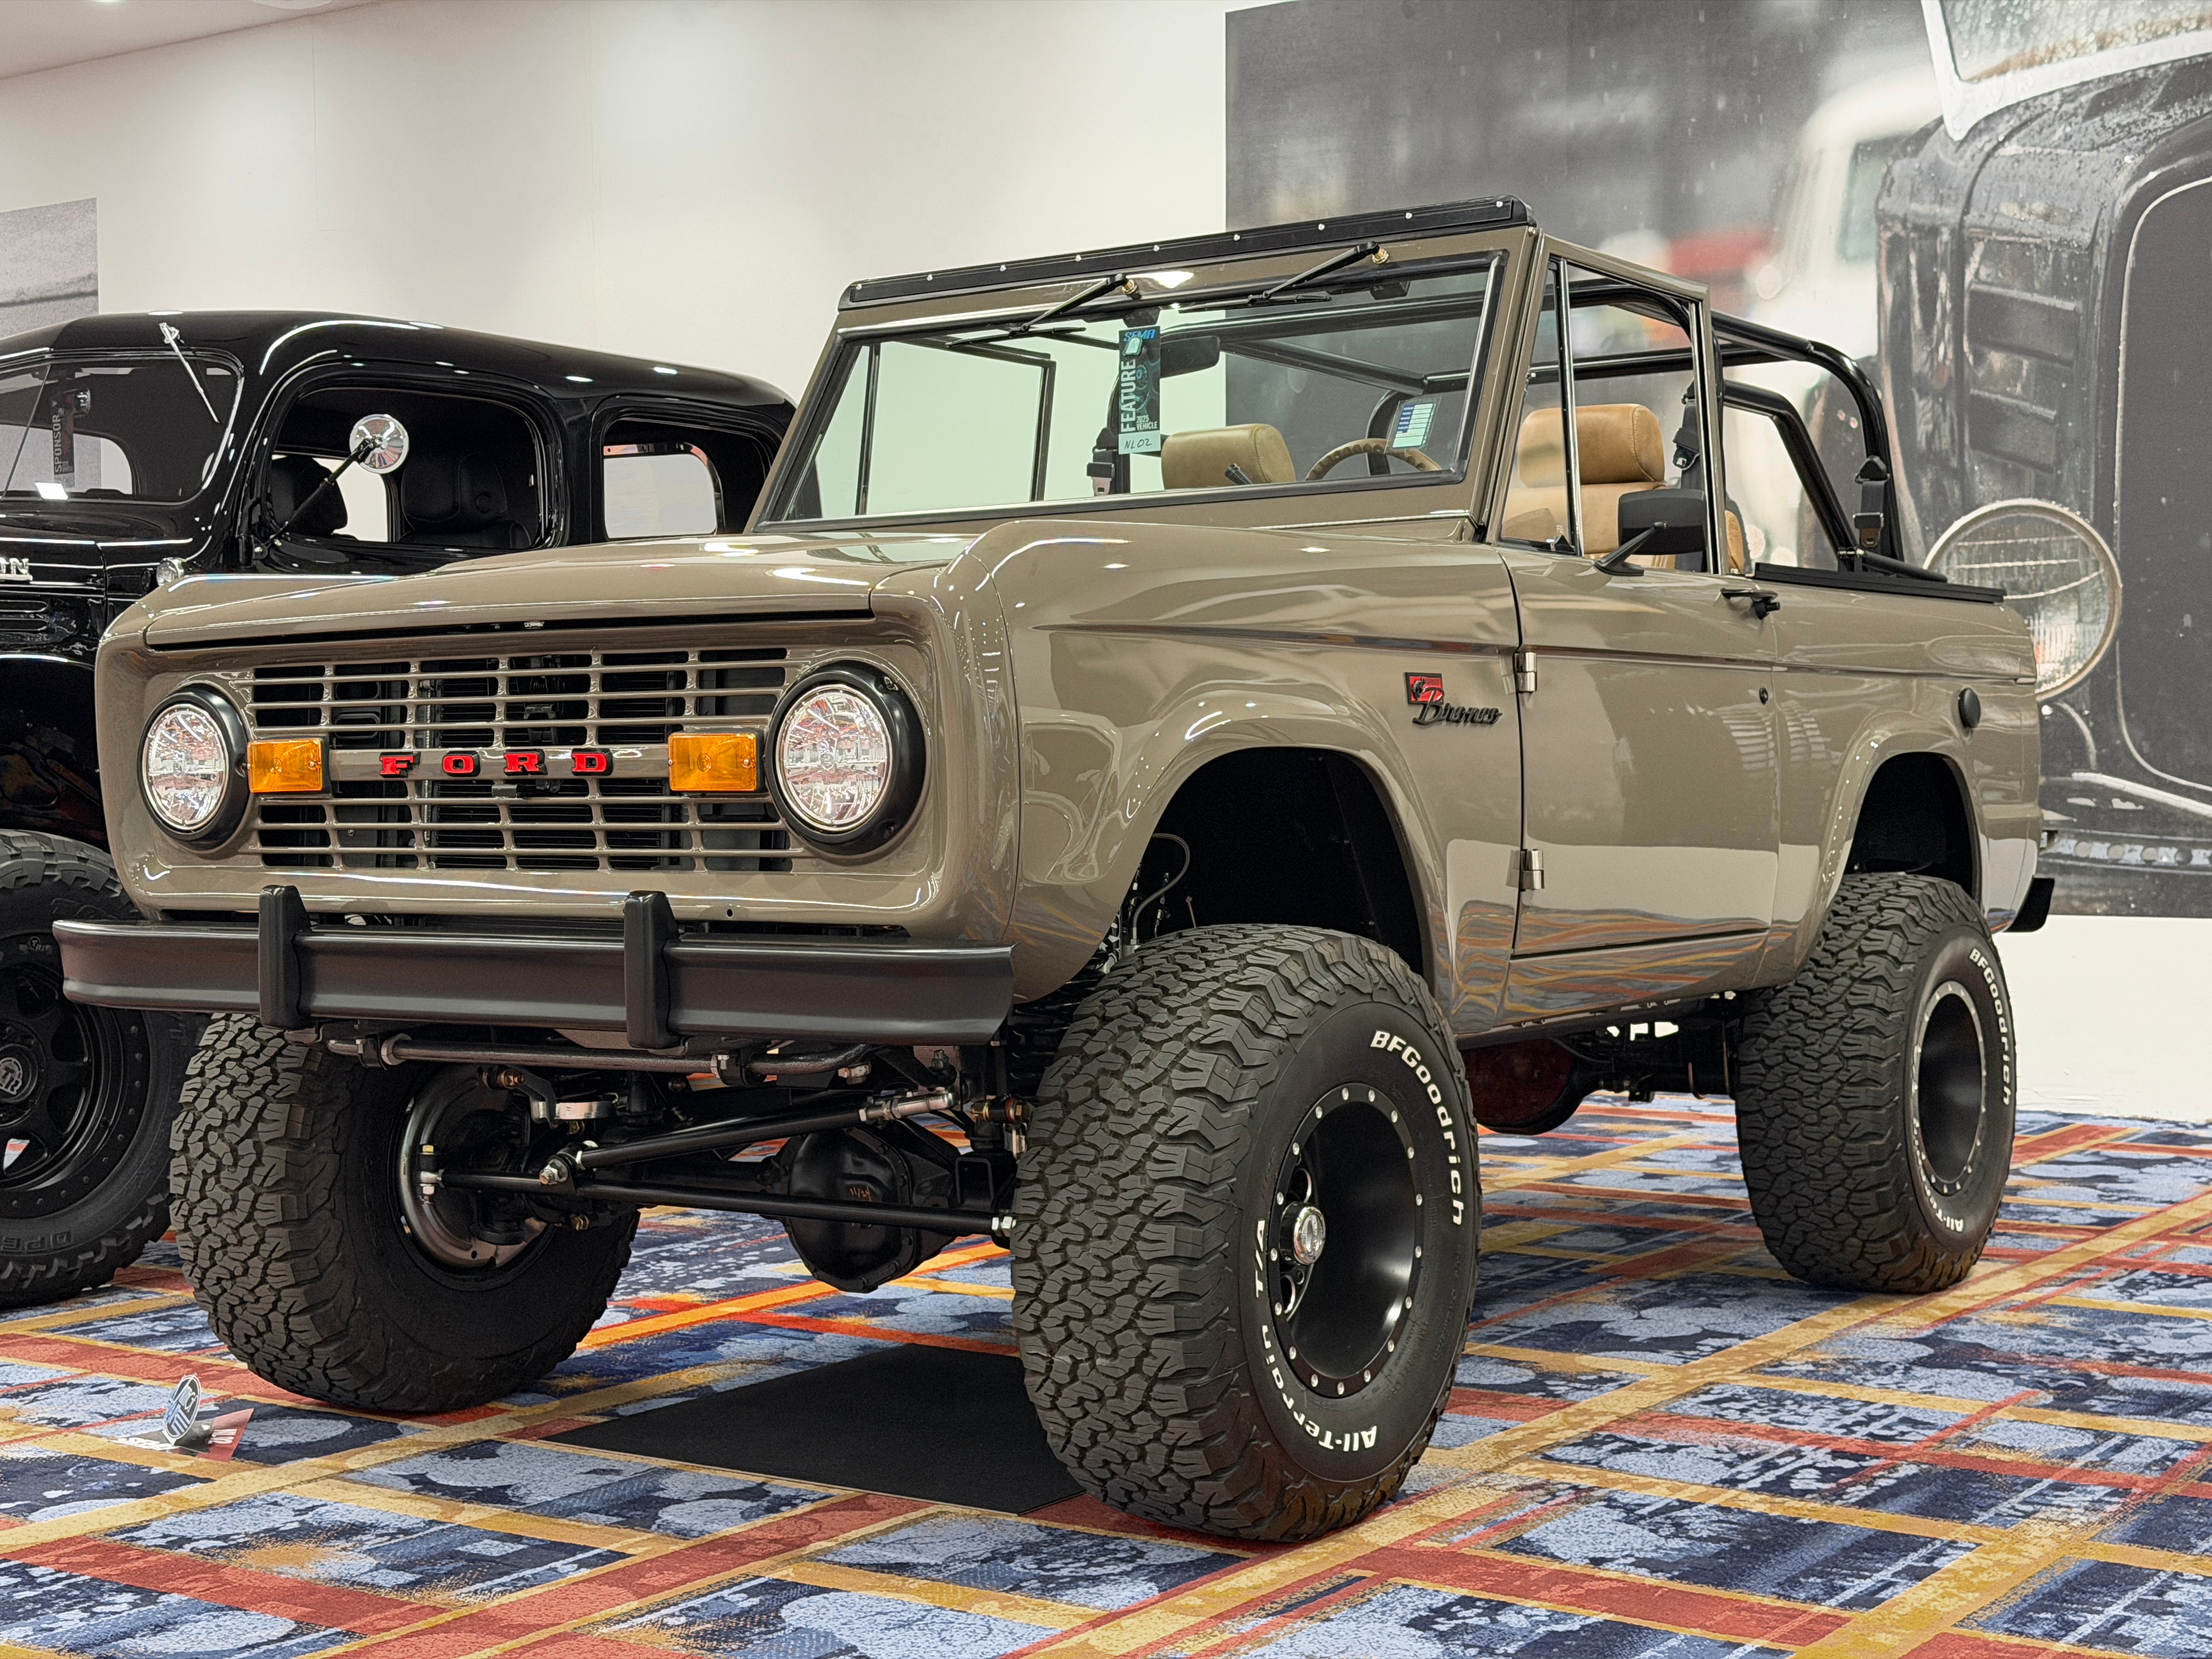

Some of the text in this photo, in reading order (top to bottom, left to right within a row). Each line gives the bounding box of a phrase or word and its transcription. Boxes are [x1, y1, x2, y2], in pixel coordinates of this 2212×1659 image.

[1123, 329, 1156, 342] SEMA
[1121, 359, 1136, 432] FEATURE
[1137, 415, 1149, 424] 2025
[52, 414, 62, 473] SPONSOR
[1136, 421, 1158, 431] VEHICLE
[1412, 687, 1503, 725] Bronco
[380, 749, 613, 777] FORD
[1969, 948, 2011, 1105] BFGoodrich
[1370, 1029, 1464, 1226] BFGoodrich
[1255, 1220, 1378, 1452] All-Terrain T/A
